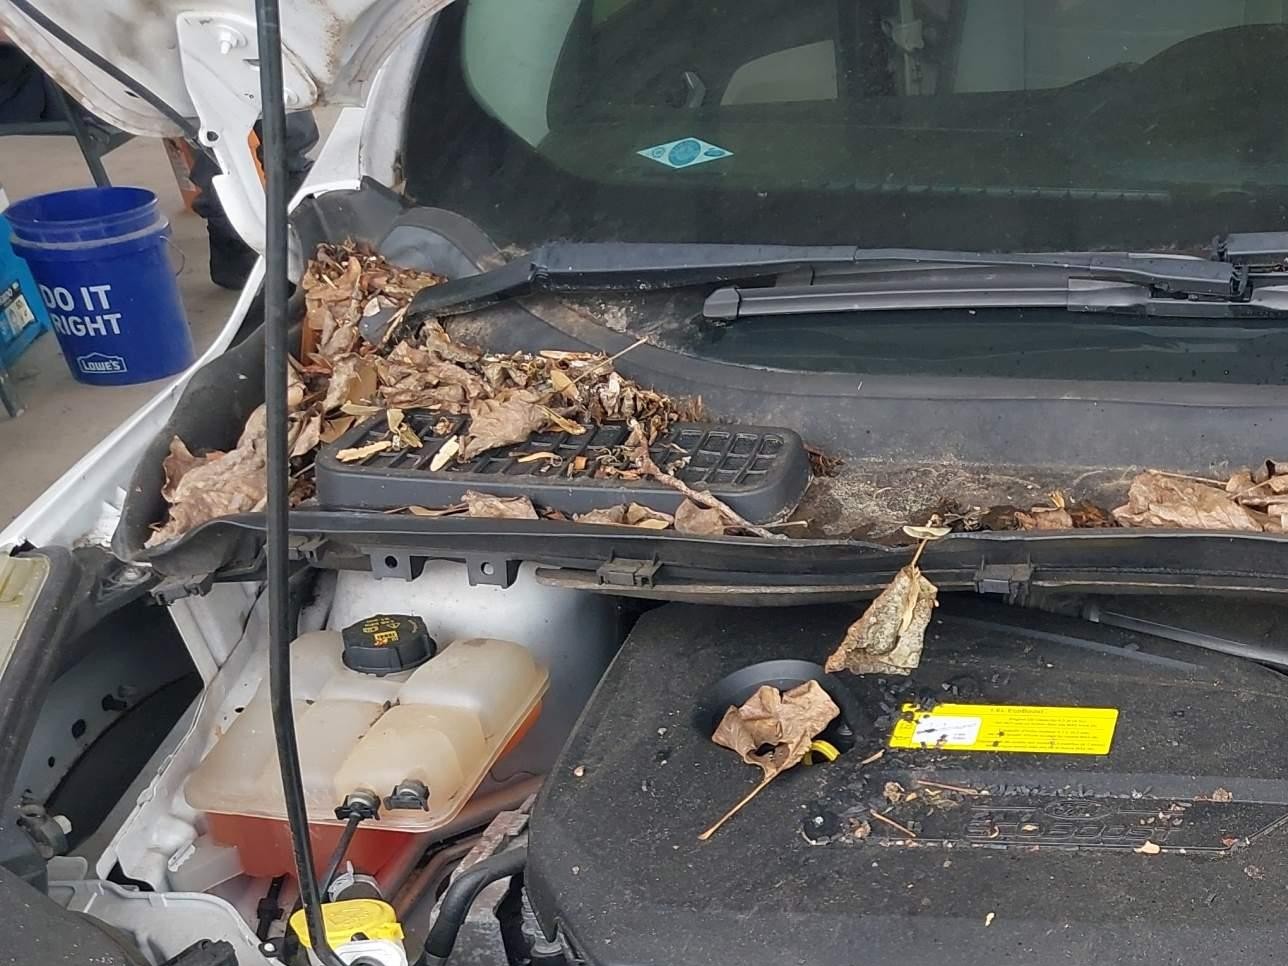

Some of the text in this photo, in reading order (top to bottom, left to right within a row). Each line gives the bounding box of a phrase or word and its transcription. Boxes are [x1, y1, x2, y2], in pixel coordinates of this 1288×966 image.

[38, 284, 75, 312] DO
[80, 284, 112, 311] IT
[51, 313, 122, 337] RIGHT
[82, 360, 121, 371] LOWE'S
